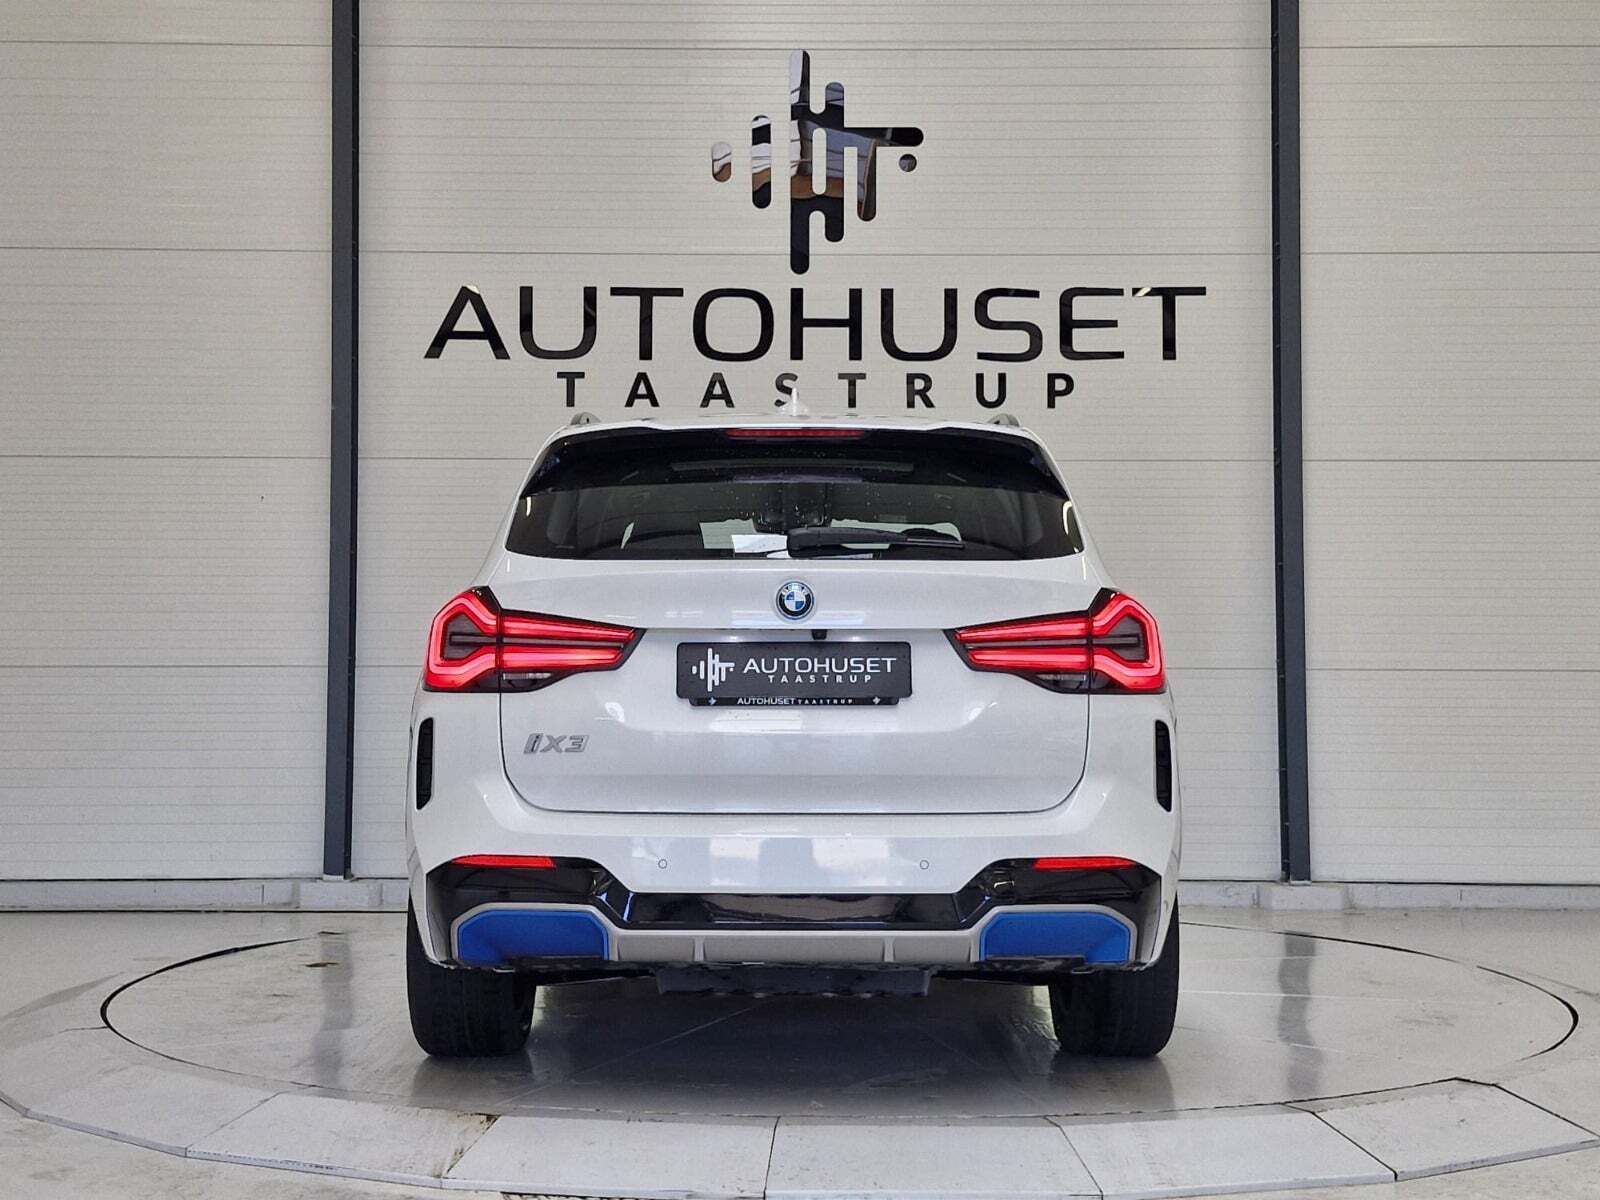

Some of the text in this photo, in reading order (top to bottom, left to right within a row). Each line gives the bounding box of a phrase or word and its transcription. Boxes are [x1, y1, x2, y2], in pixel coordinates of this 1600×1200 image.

[424, 285, 1206, 361] AUTOHUSET
[557, 372, 1075, 409] TAASTRUP
[743, 658, 897, 674] AUTOHUSET
[768, 675, 871, 683] TAASTRUP
[737, 697, 795, 705] AUTOHUSET
